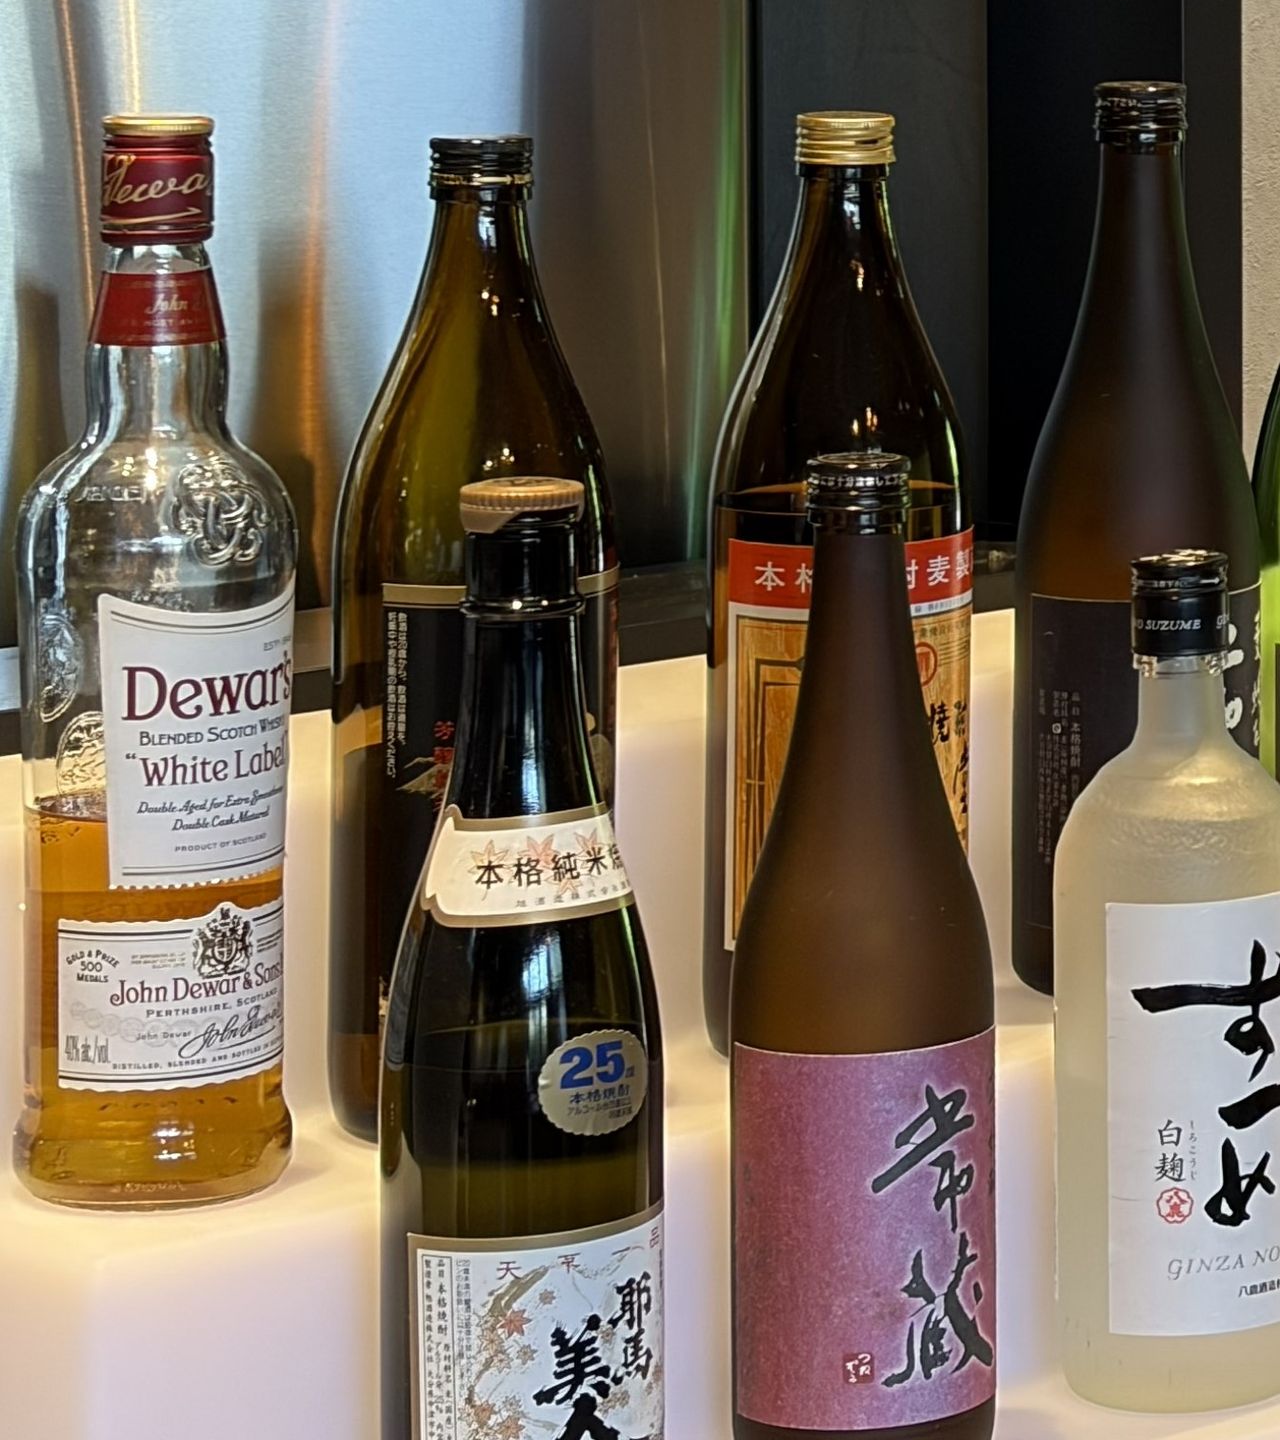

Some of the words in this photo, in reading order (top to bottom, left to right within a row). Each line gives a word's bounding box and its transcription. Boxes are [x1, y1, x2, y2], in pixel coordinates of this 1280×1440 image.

[103, 155, 213, 206] Dewa
[1145, 618, 1201, 632] SUZUME
[122, 650, 291, 721] Dewar's
[139, 730, 204, 746] BLENDED
[207, 722, 258, 743] SCOTCH
[260, 716, 285, 734] WHIS
[137, 800, 177, 815] Double
[179, 799, 206, 815] Aged
[207, 798, 225, 813] for
[172, 818, 210, 831] Double
[175, 841, 218, 852] PRODUCT
[66, 949, 85, 966] GOLD
[95, 948, 121, 969] PRIZE
[80, 961, 103, 972] 500
[76, 972, 109, 983] MEDALS
[110, 979, 168, 1006] John
[173, 974, 241, 1001] Dewar
[242, 969, 253, 989] &
[236, 986, 278, 1008] SCOTLAND
[136, 1032, 159, 1041] John
[163, 1030, 192, 1039] Dewar
[168, 1056, 207, 1069] BLENDED
[569, 1084, 630, 1104] 本格焼酎
[1154, 1118, 1187, 1183] 白麹
[1168, 1253, 1244, 1281] GINZA
[1252, 1245, 1280, 1267] NO
[437, 1282, 448, 1336] 本格焼酎
